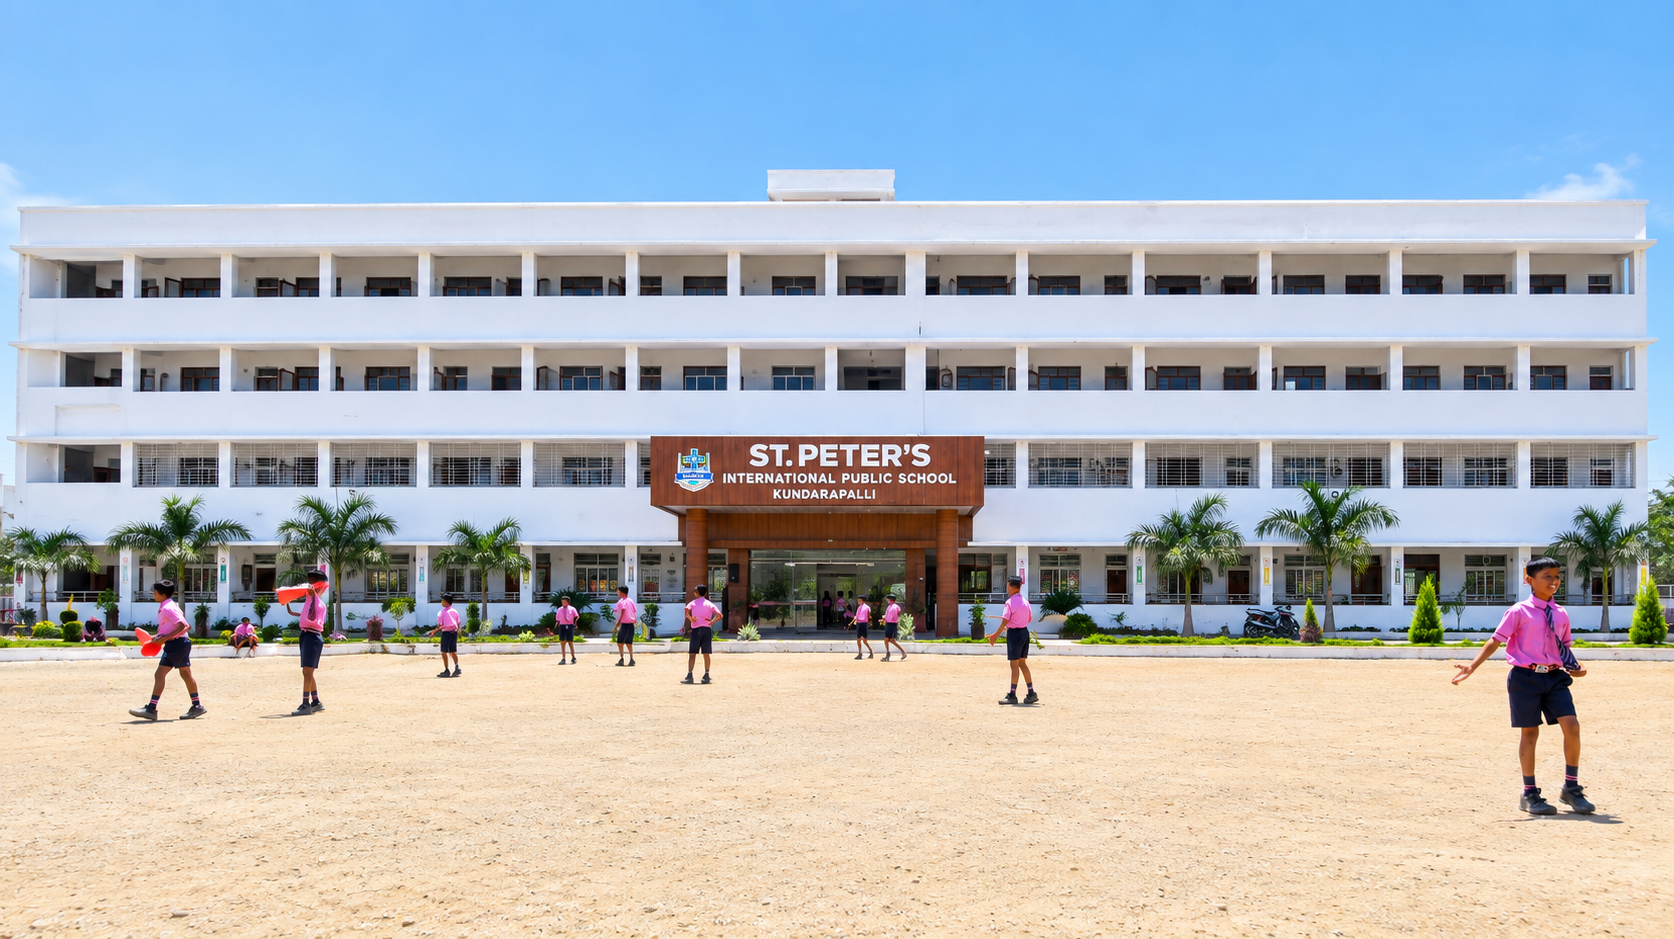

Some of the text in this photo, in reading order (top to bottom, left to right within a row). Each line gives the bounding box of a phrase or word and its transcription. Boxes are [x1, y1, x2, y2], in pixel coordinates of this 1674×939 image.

[722, 472, 957, 484] INTERNATIONAL PUBLIC SCHOOL
[773, 488, 876, 500] KUNDARAPALLI
